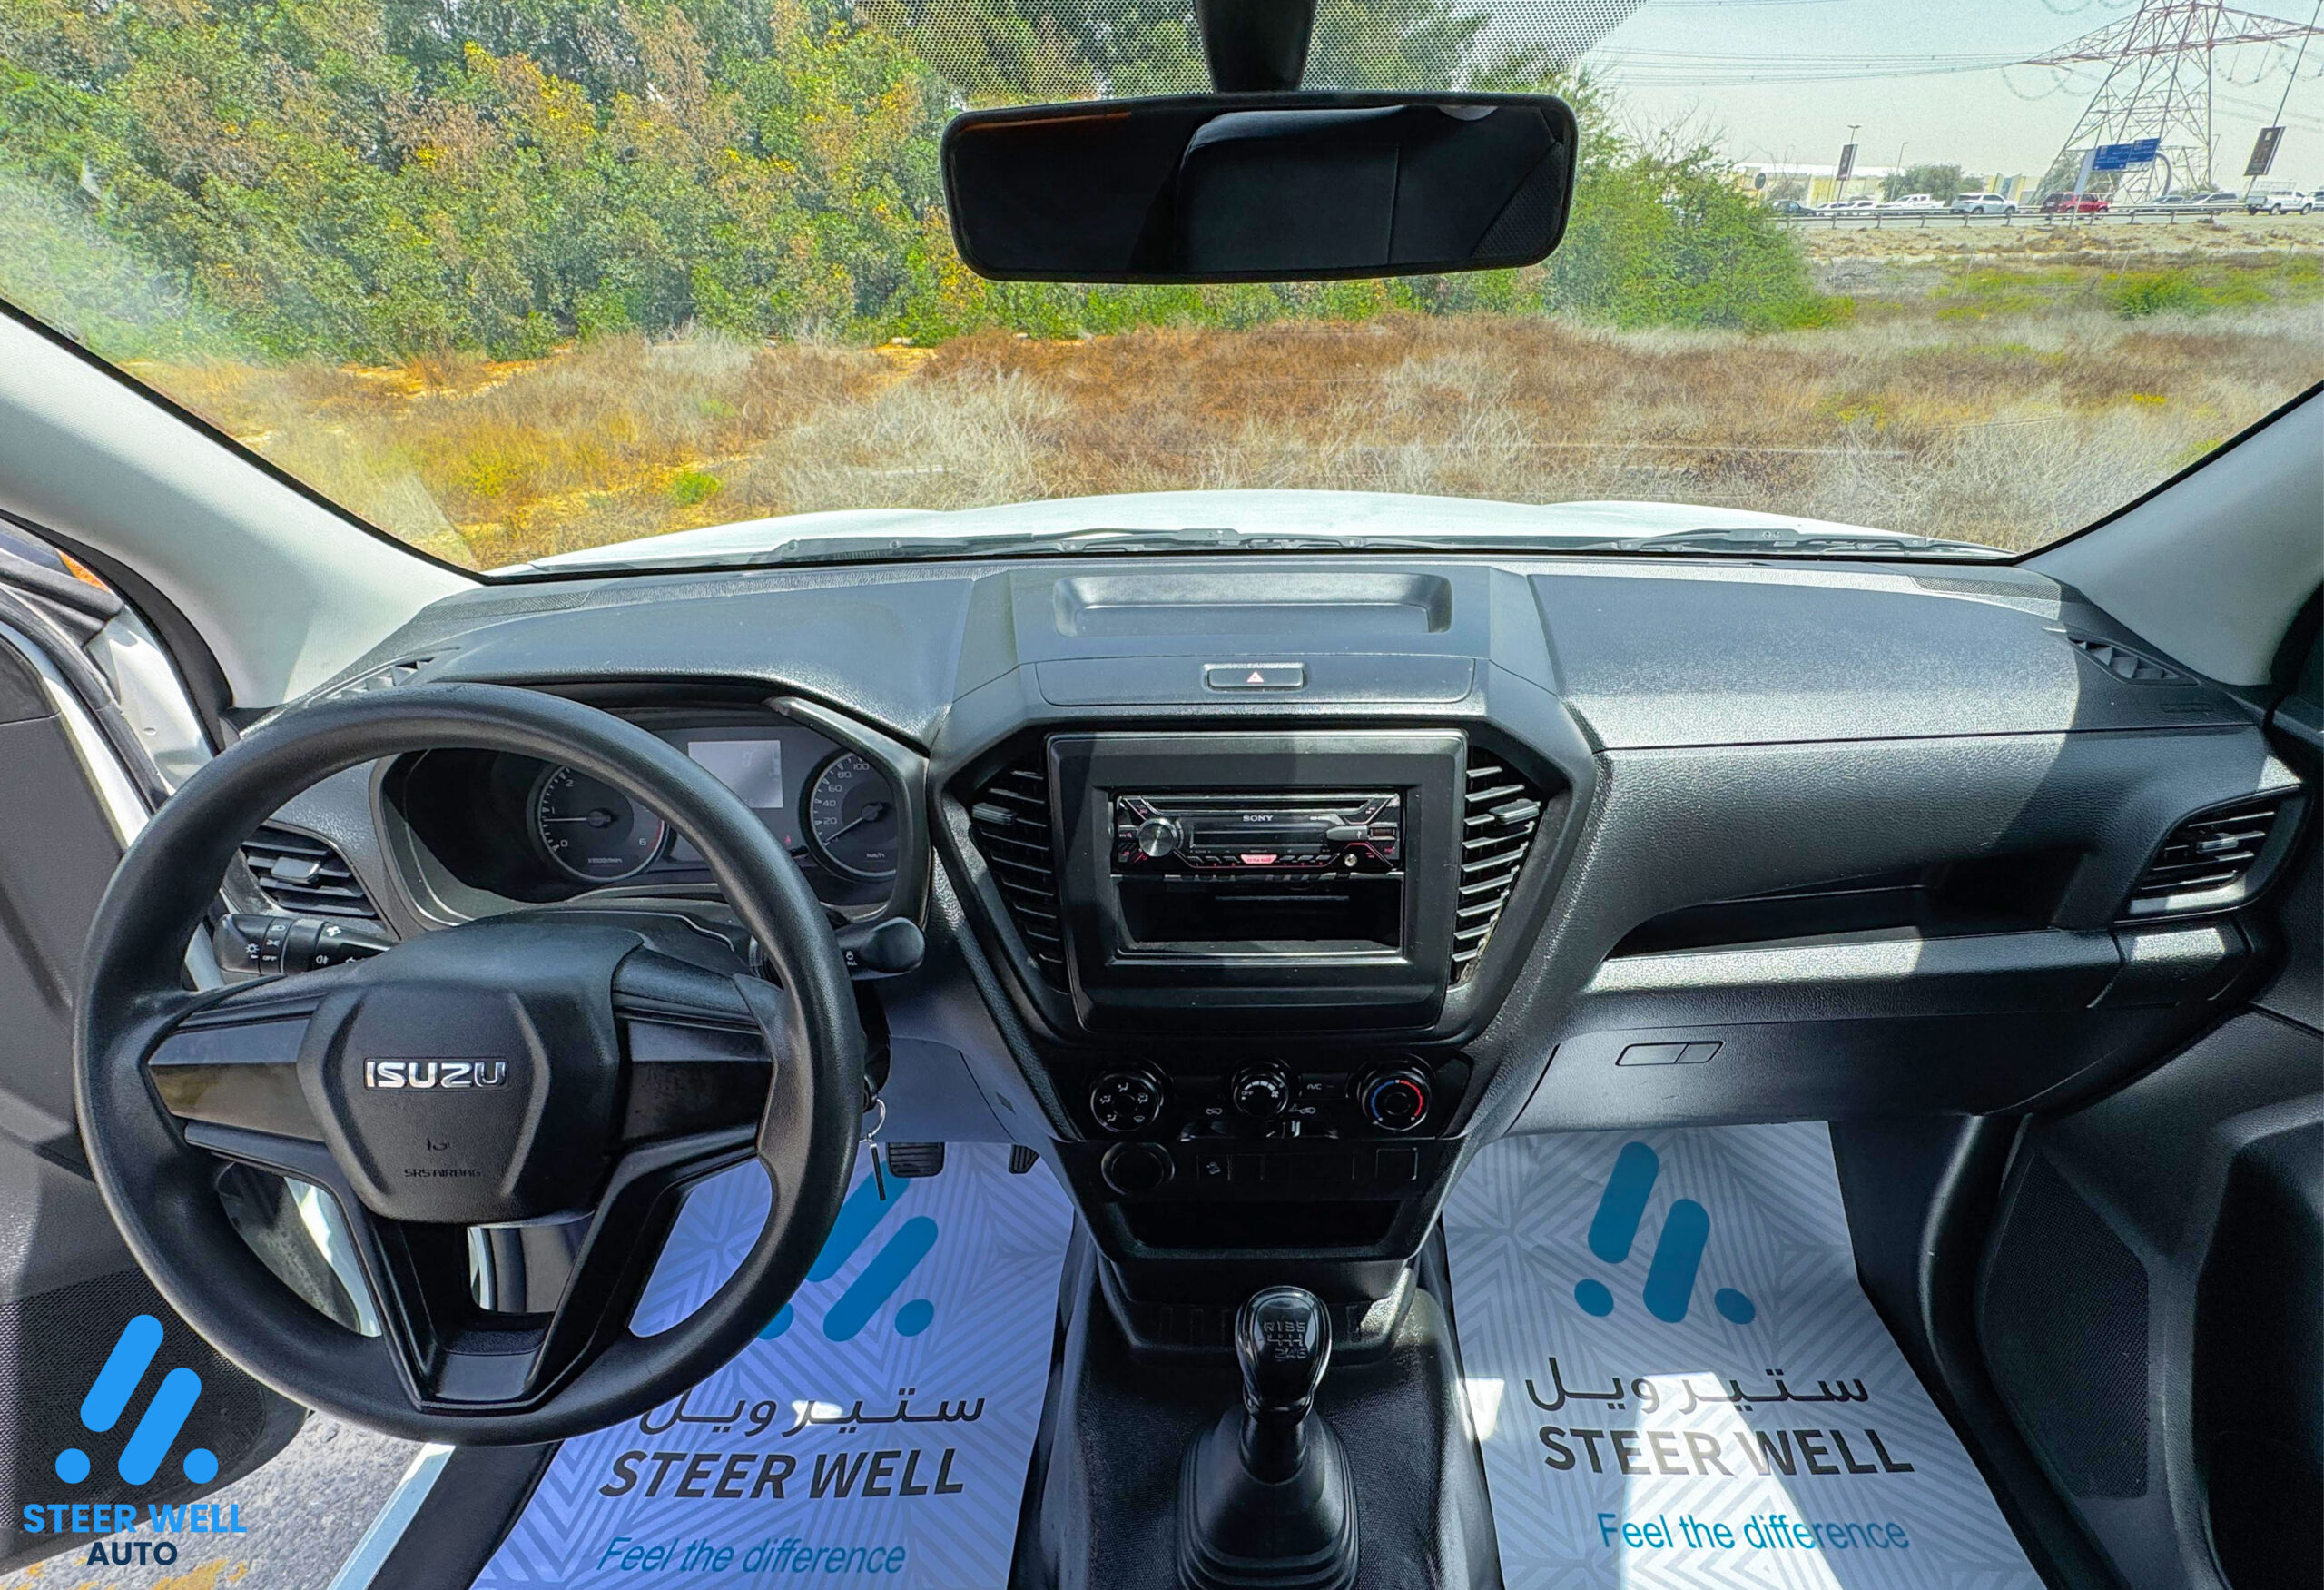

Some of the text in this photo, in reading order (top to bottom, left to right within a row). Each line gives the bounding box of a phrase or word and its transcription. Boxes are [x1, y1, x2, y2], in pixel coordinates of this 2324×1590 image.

[566, 779, 574, 787] 2
[560, 839, 568, 847] 0
[366, 1061, 507, 1089] ISUZU
[404, 1169, 481, 1178] SRS AIRBAG
[1525, 1357, 1869, 1416] ستير ويل
[1539, 1426, 1915, 1476] STEER WELL
[599, 1448, 965, 1499] STEER WELL
[1597, 1513, 1909, 1549] Feel the difference
[596, 1536, 906, 1574] Feel the difference
